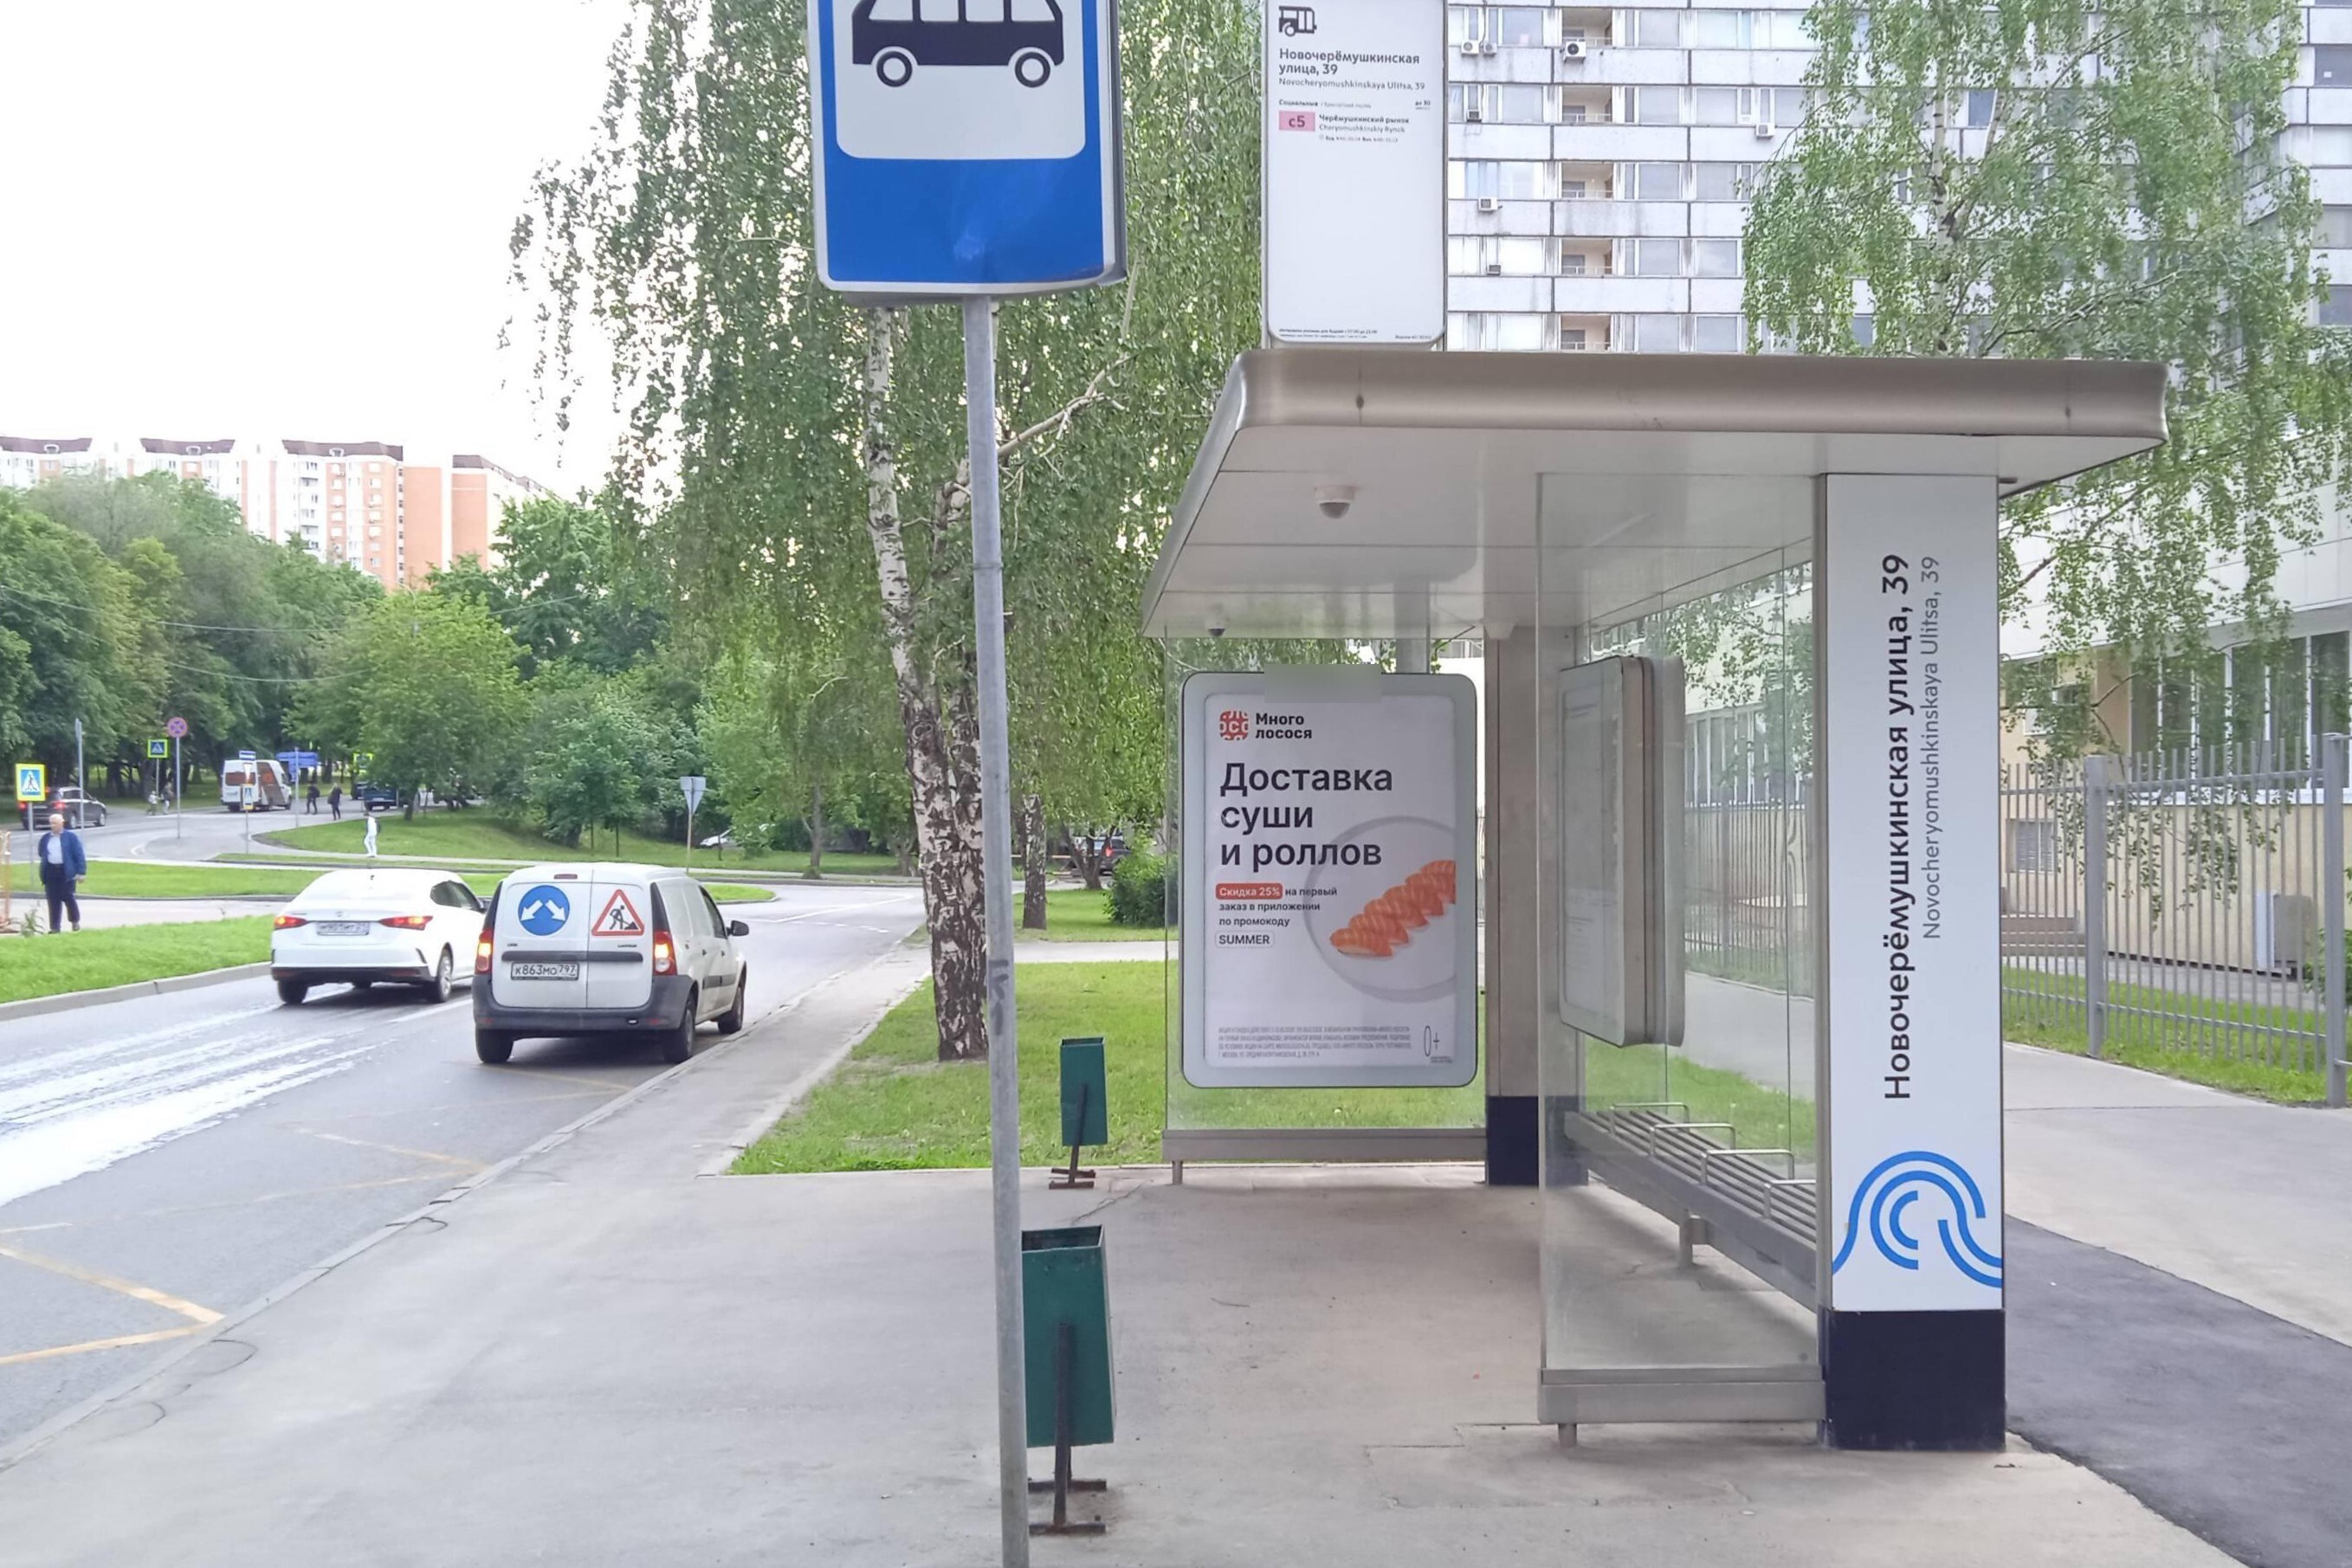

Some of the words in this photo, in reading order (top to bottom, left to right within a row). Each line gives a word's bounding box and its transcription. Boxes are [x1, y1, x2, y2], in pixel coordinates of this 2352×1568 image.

[1278, 64, 1319, 76] улица,
[1321, 63, 1338, 75] 39
[1279, 48, 1420, 65] Новочерёмушкинская
[1882, 554, 1909, 595] 39
[1921, 556, 1940, 583] 39
[1919, 590, 1942, 655] Ulitsa,
[1888, 607, 1915, 716] улица,
[1256, 713, 1305, 726] Много
[1255, 729, 1313, 739] лосося
[1219, 762, 1393, 797] Доставка
[1920, 662, 1943, 939] Novocheryomushkinskaya
[1220, 806, 1314, 836] суши
[1220, 842, 1241, 866] и
[1252, 842, 1383, 873] роллов
[1218, 887, 1257, 898] Скидка
[1258, 887, 1282, 897] 25%
[1299, 887, 1338, 898] первый
[1218, 903, 1247, 912] заказ
[1257, 903, 1321, 913] приложении
[1883, 726, 1916, 1099] Новочерёмушкинская
[1218, 918, 1231, 926] по
[1233, 918, 1291, 927] промокоду
[1218, 934, 1270, 945] SUMMER
